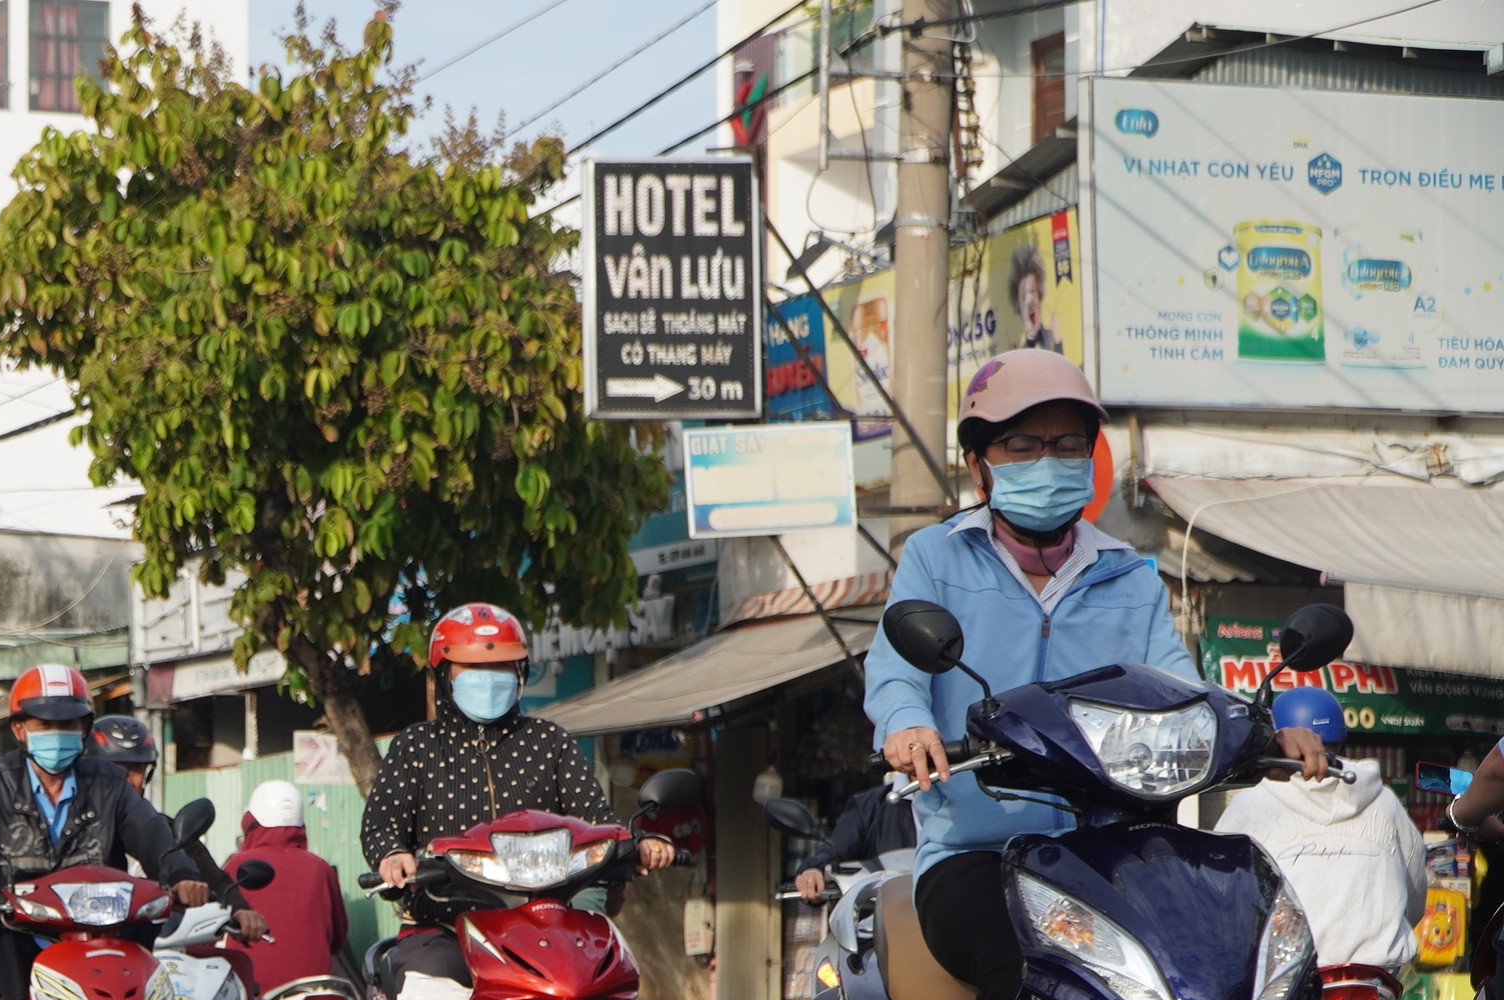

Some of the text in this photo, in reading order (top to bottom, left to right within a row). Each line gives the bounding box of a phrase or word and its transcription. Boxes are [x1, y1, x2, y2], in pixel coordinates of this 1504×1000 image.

[1207, 161, 1248, 179] CON
[1256, 162, 1294, 181] YÊU
[603, 174, 746, 237] HOTEL
[1413, 297, 1437, 312] A2
[1126, 325, 1223, 341] THÔNG MINH
[621, 337, 733, 366] CÓ THANG MÁY
[687, 375, 716, 400] 30
